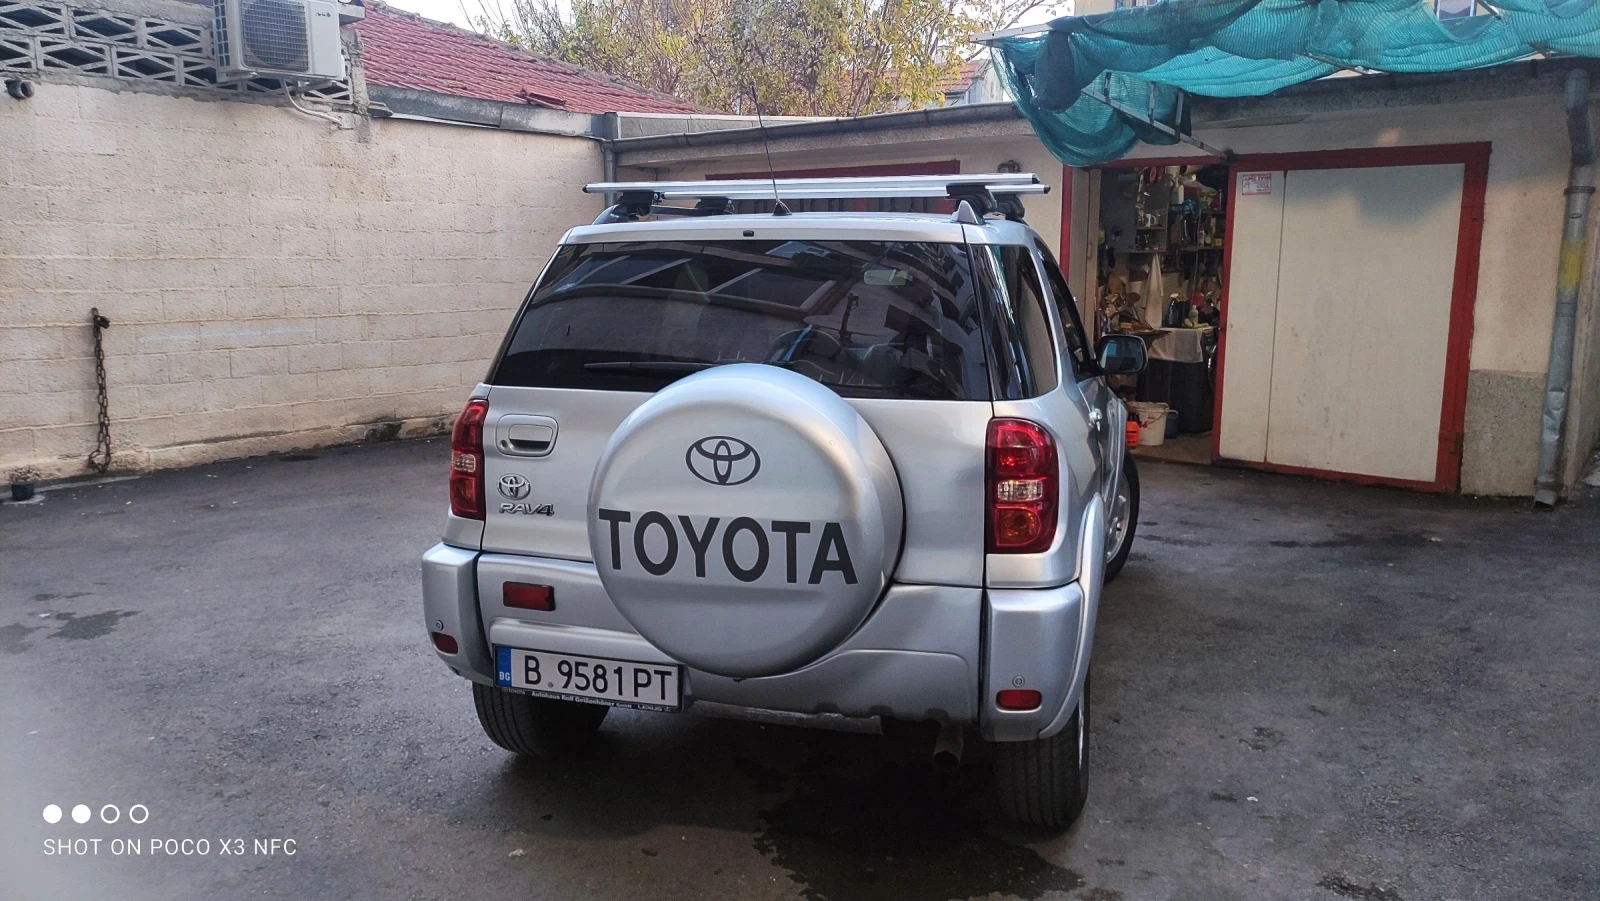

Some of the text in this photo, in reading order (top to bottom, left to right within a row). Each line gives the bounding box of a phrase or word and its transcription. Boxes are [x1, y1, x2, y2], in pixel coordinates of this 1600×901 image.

[499, 502, 554, 516] RAV4
[598, 508, 859, 585] TOYOTA
[499, 671, 511, 681] BG
[524, 655, 672, 700] B 9581 PT
[531, 691, 560, 700] Autohaus
